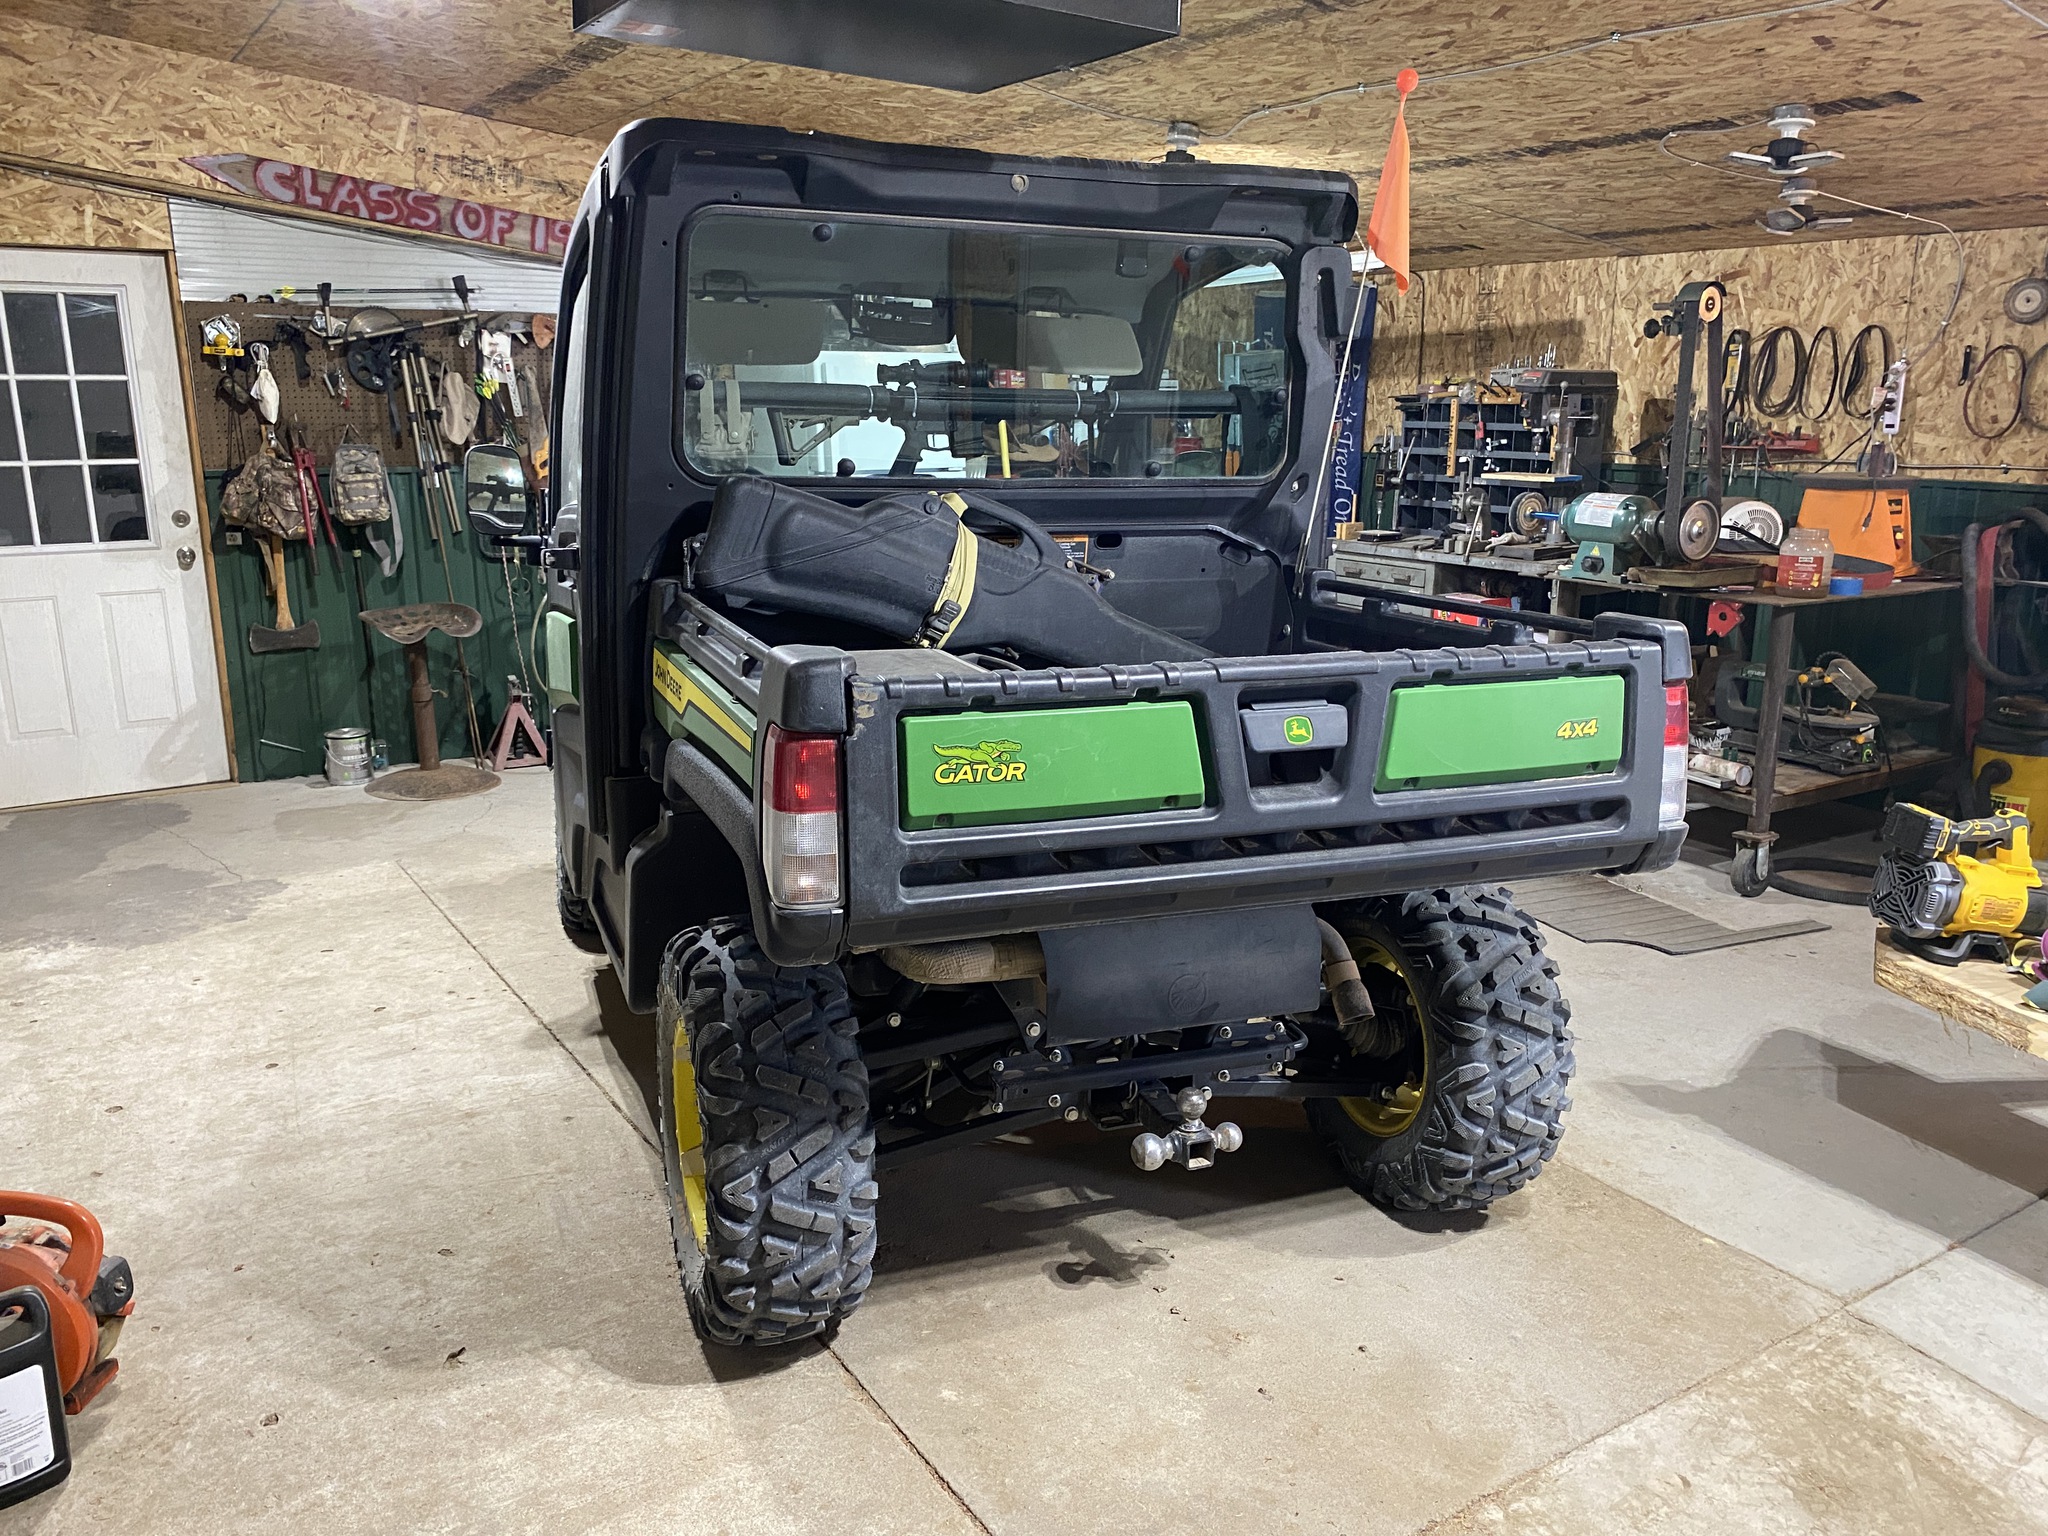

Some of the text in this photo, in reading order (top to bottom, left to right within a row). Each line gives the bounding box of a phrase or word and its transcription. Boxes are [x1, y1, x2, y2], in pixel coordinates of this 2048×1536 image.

[257, 159, 438, 229] CLASS
[454, 201, 516, 244] OF
[1334, 431, 1354, 495] Tread
[935, 761, 1026, 784] GATOR
